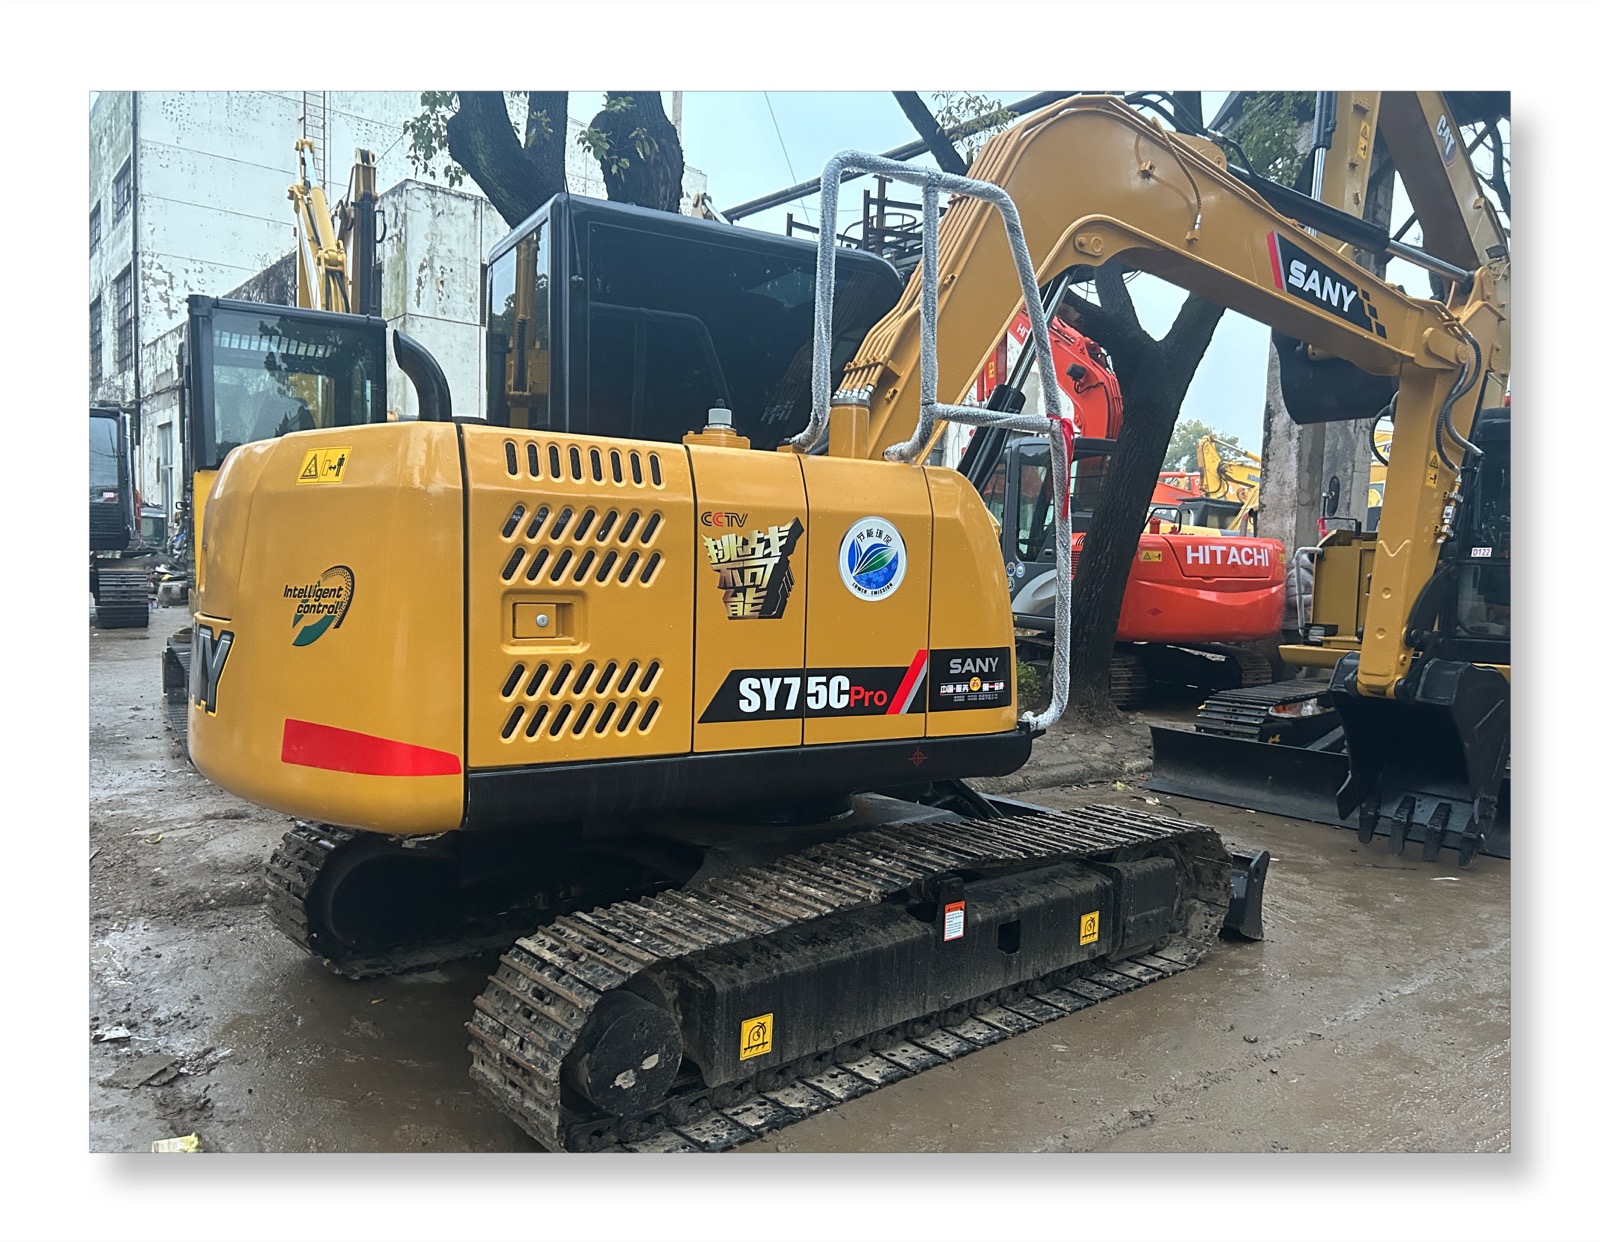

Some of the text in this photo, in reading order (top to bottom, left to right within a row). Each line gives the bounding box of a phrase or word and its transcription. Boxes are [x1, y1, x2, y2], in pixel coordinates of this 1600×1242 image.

[1436, 114, 1455, 156] CAT
[1288, 259, 1357, 313] SANY
[701, 511, 748, 527] CCTV
[701, 520, 794, 563] 挑战
[1186, 545, 1269, 567] HITACHI
[283, 584, 343, 602] Intelligent
[296, 600, 339, 614] control
[949, 657, 999, 674] SANY
[738, 675, 888, 713] SY75C Pro
